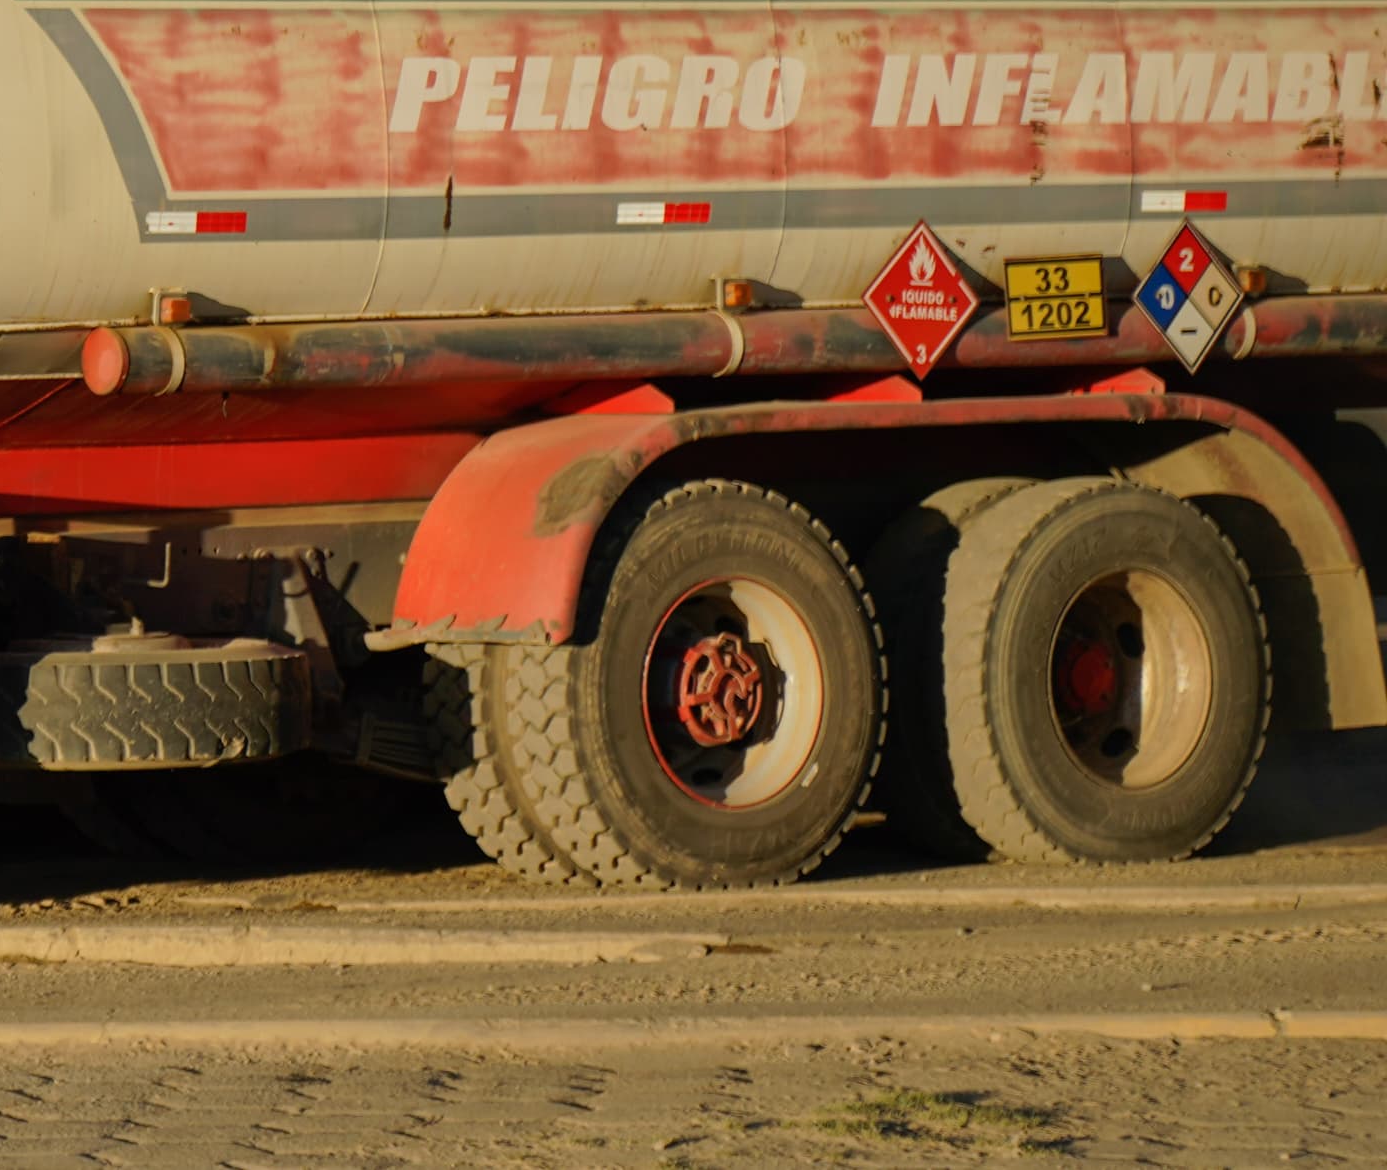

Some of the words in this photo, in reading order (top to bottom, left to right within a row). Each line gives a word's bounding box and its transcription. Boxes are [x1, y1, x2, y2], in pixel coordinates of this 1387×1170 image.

[387, 54, 807, 133] PELIGRO
[870, 51, 1387, 128] INFLAMABL
[1178, 246, 1195, 273] 2
[1035, 266, 1070, 294] 33
[1021, 300, 1092, 330] 1202
[915, 343, 928, 365] 3
